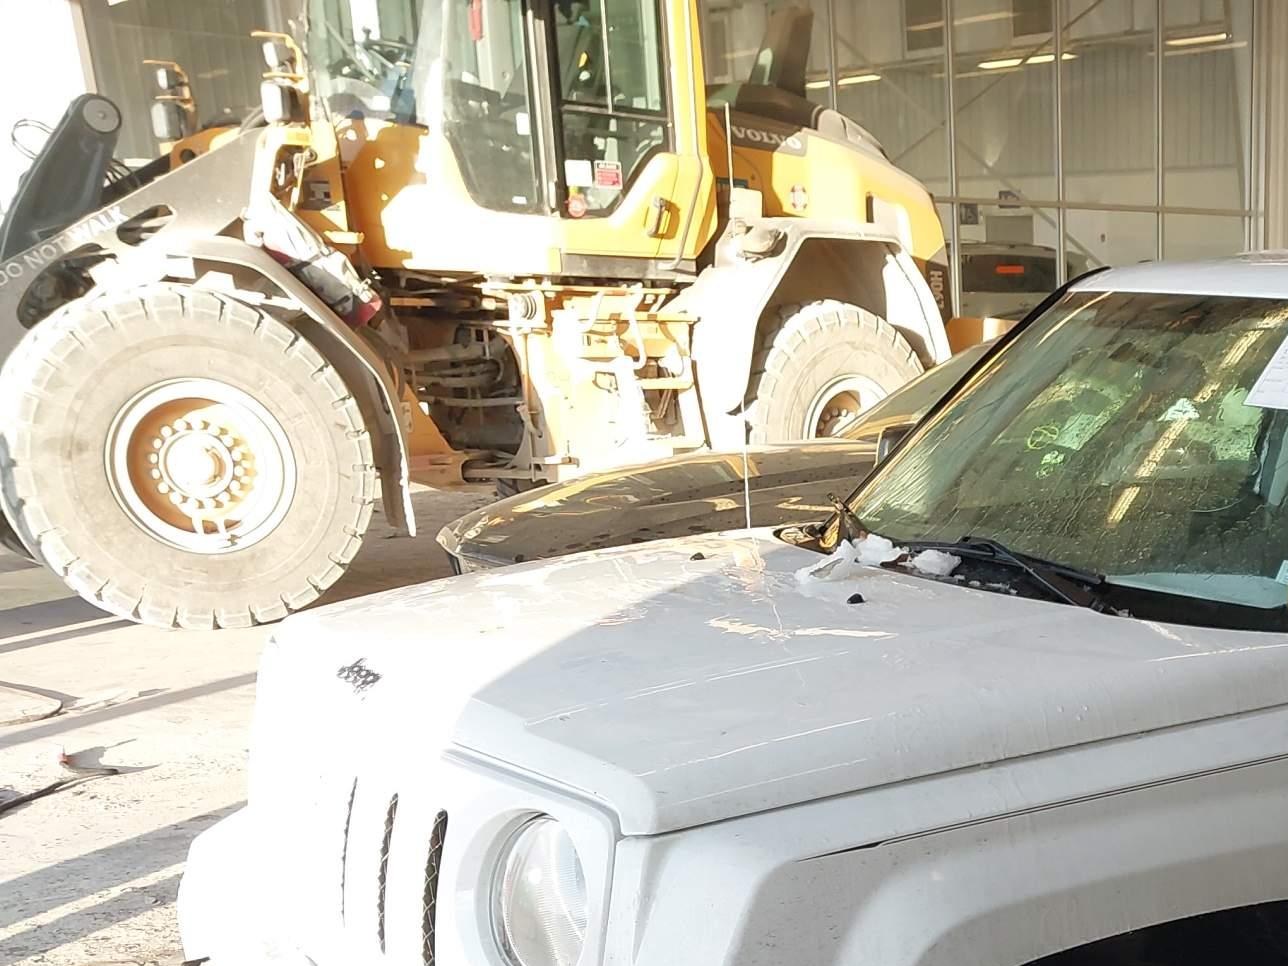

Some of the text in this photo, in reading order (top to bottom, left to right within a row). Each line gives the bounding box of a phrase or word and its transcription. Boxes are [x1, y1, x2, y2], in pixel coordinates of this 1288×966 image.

[731, 125, 802, 149] VOLVO
[23, 236, 66, 269] NOT
[66, 205, 129, 243] WALK
